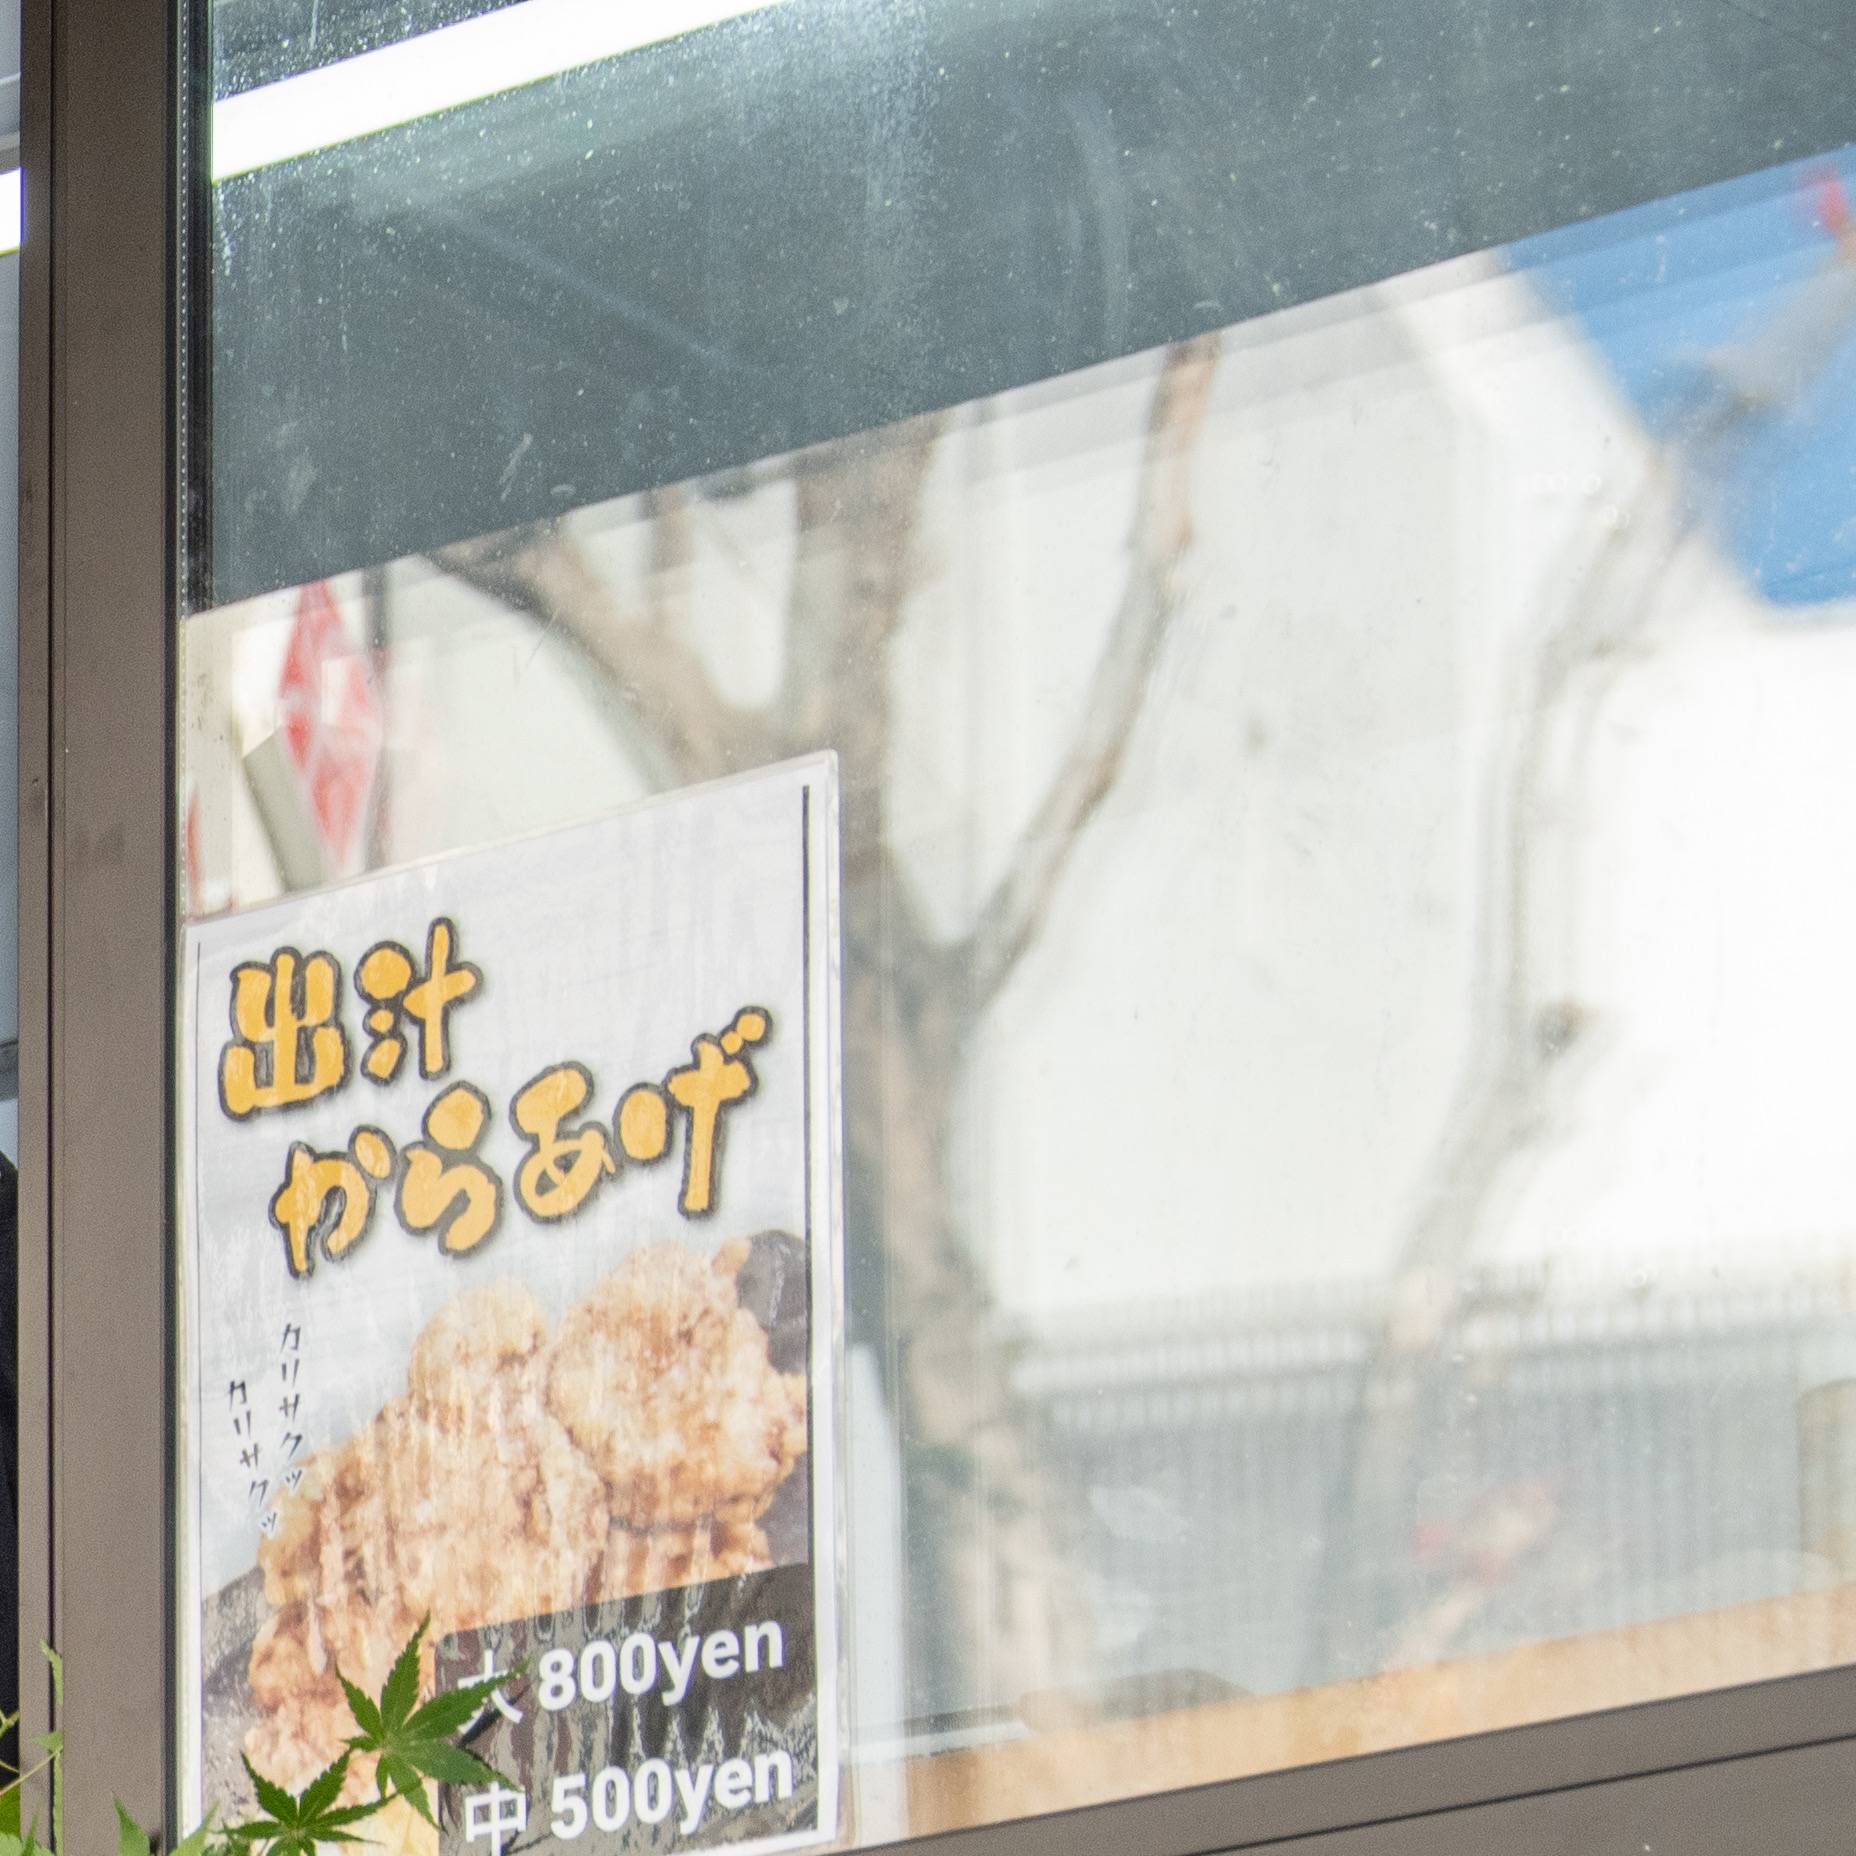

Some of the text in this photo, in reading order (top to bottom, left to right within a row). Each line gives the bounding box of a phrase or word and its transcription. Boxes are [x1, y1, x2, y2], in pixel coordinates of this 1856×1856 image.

[220, 917, 483, 1122] 出汁
[269, 1007, 773, 1279] からあげ
[538, 1620, 785, 1712] 800yen
[550, 1750, 793, 1840] 500yen
